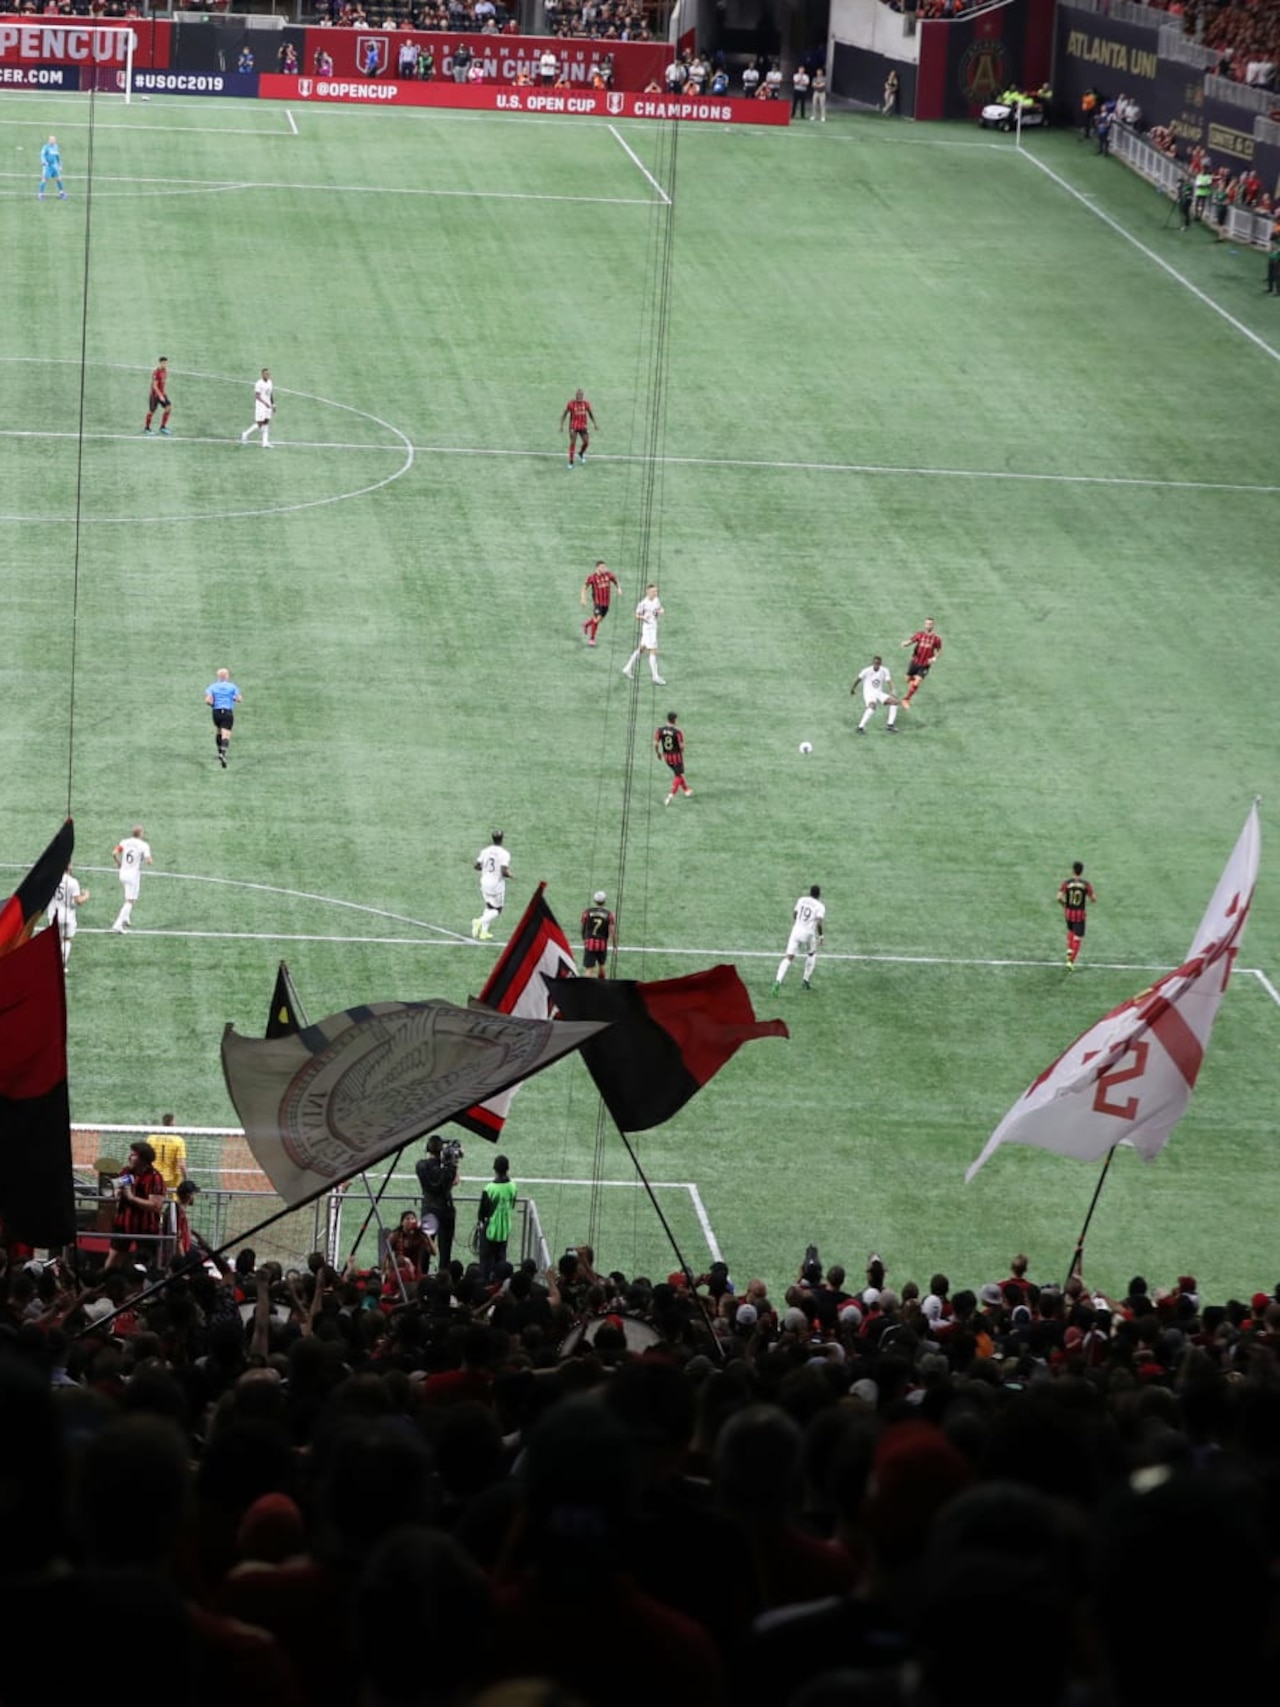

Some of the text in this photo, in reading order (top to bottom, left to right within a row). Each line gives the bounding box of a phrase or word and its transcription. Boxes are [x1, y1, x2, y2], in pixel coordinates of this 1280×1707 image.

[1066, 30, 1128, 72] ATLANTA
[135, 75, 223, 91] #USOC2019
[316, 82, 398, 99] @OPENCUP
[496, 94, 596, 112] U.S. OPEN CUP
[634, 102, 732, 120] CHAMPIONS
[664, 735, 674, 751] 8
[126, 850, 134, 864] 6
[799, 905, 812, 921] 19
[593, 918, 603, 936] 7
